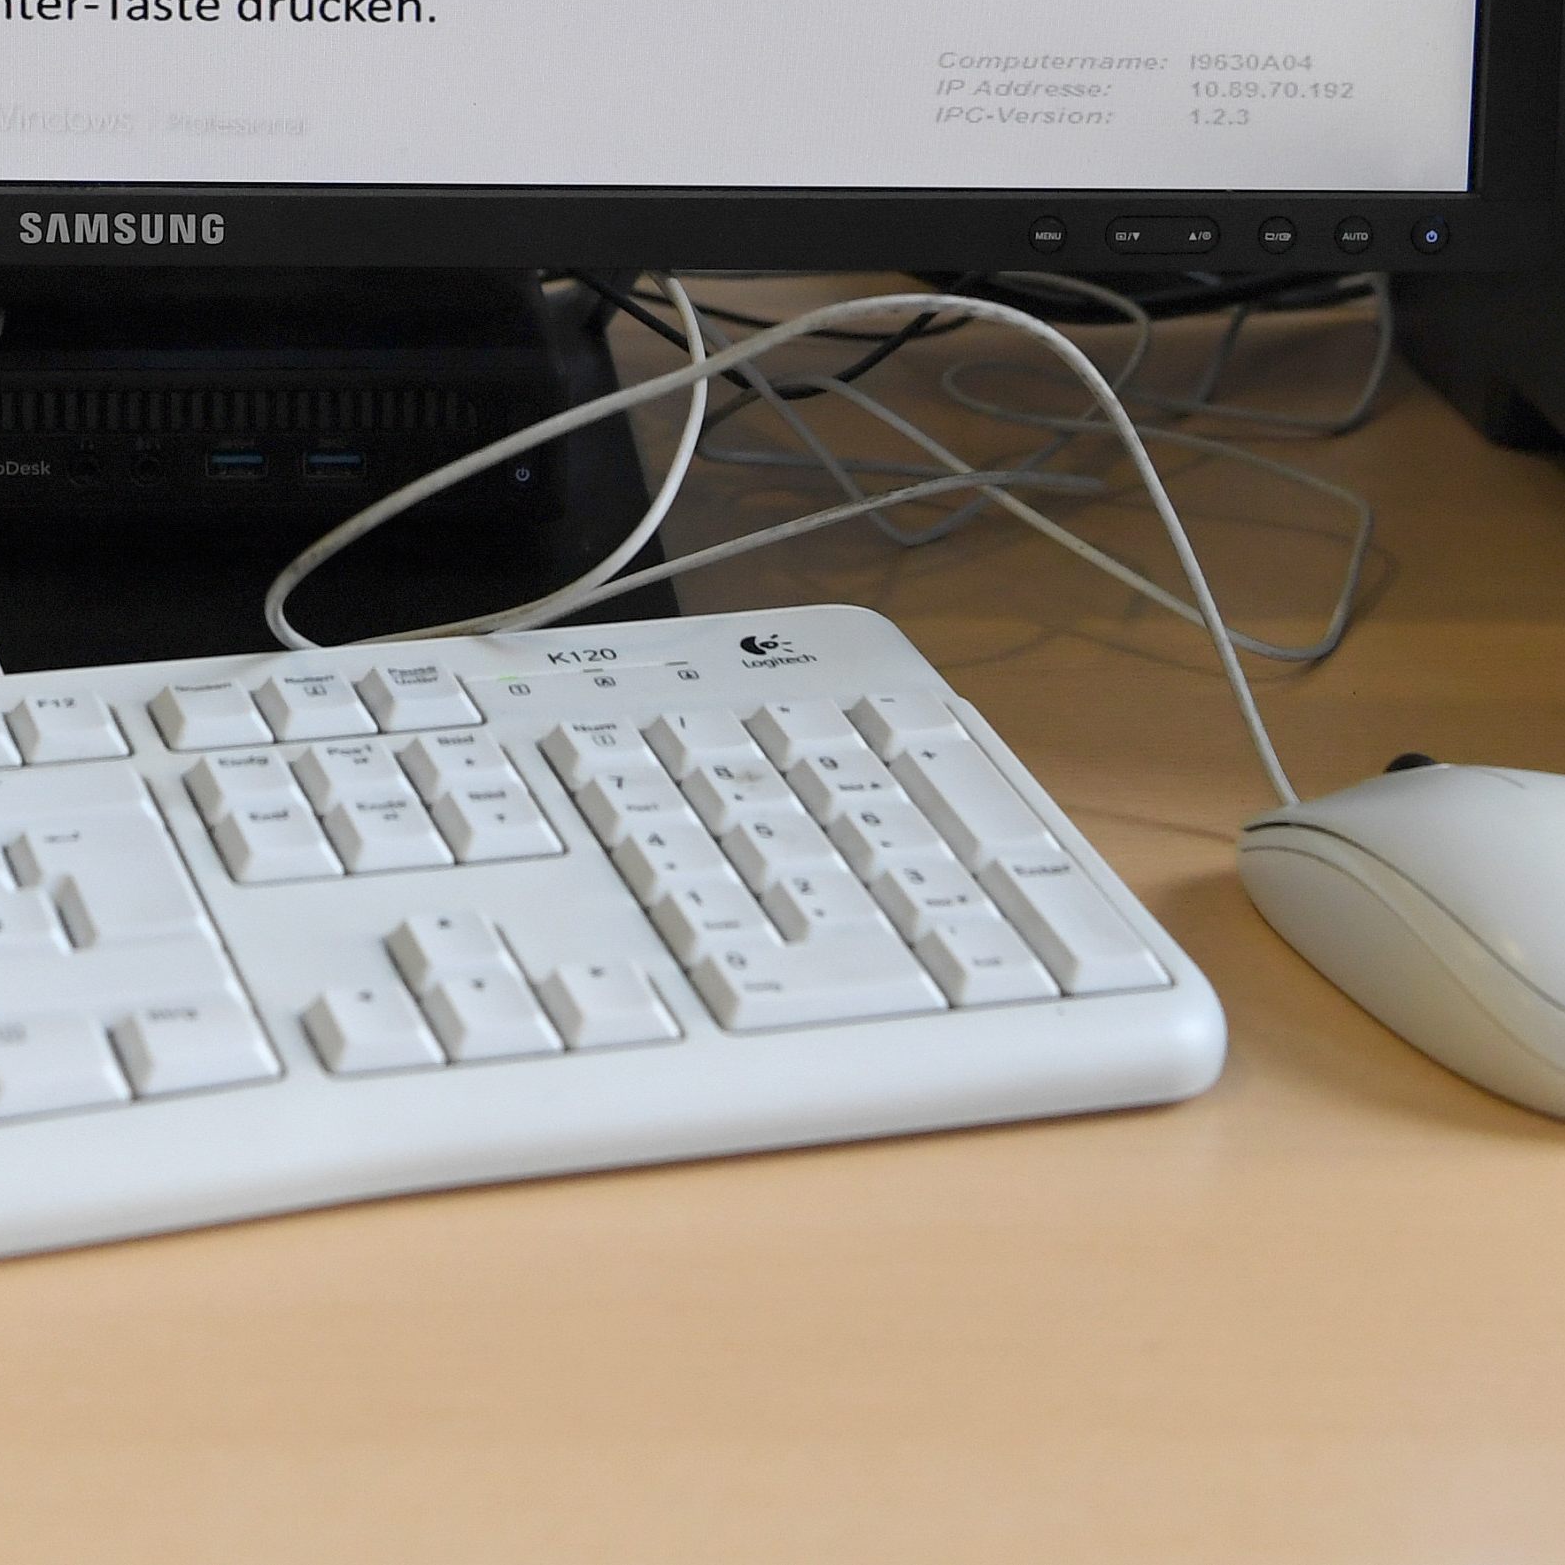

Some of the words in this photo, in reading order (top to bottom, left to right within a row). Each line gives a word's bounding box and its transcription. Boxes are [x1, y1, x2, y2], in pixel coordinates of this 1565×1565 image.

[939, 52, 1167, 76] Computername:
[937, 79, 965, 95] IP
[974, 80, 1112, 97] Addresse:
[937, 107, 1112, 124] IPC-Version:
[1192, 108, 1249, 125] 1.2.3
[19, 212, 225, 245] SAMSUNG
[1035, 230, 1062, 242] MENU
[1342, 231, 1369, 242] AUTO
[548, 648, 618, 665] K120
[741, 648, 818, 669] Logitech
[36, 697, 76, 709] F12
[572, 721, 618, 732] Num
[819, 755, 839, 770] 9
[608, 774, 624, 789] 7
[647, 832, 666, 847] 4
[1013, 863, 1072, 877] Enter
